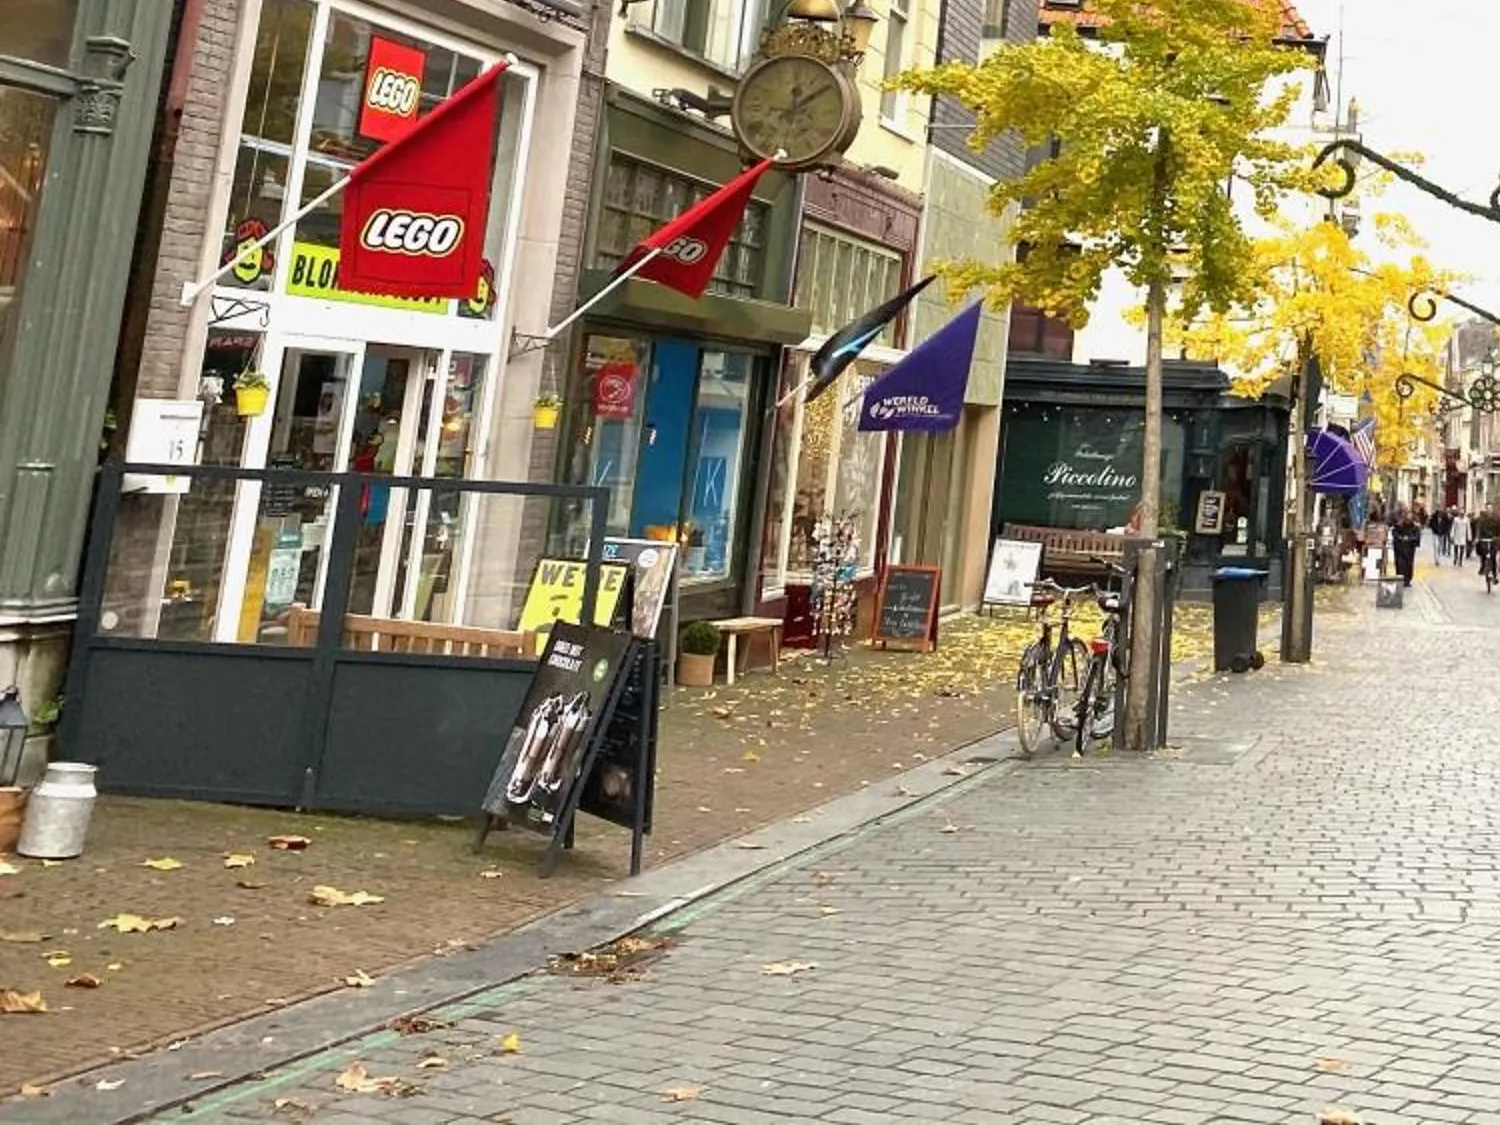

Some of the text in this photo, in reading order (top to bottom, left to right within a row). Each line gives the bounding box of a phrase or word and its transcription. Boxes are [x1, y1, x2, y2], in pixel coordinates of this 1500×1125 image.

[369, 68, 419, 115] LEGO
[363, 210, 463, 255] LEGO
[882, 395, 930, 407] WERELD
[896, 404, 941, 415] WINKEL
[1043, 461, 1137, 488] Piccolino
